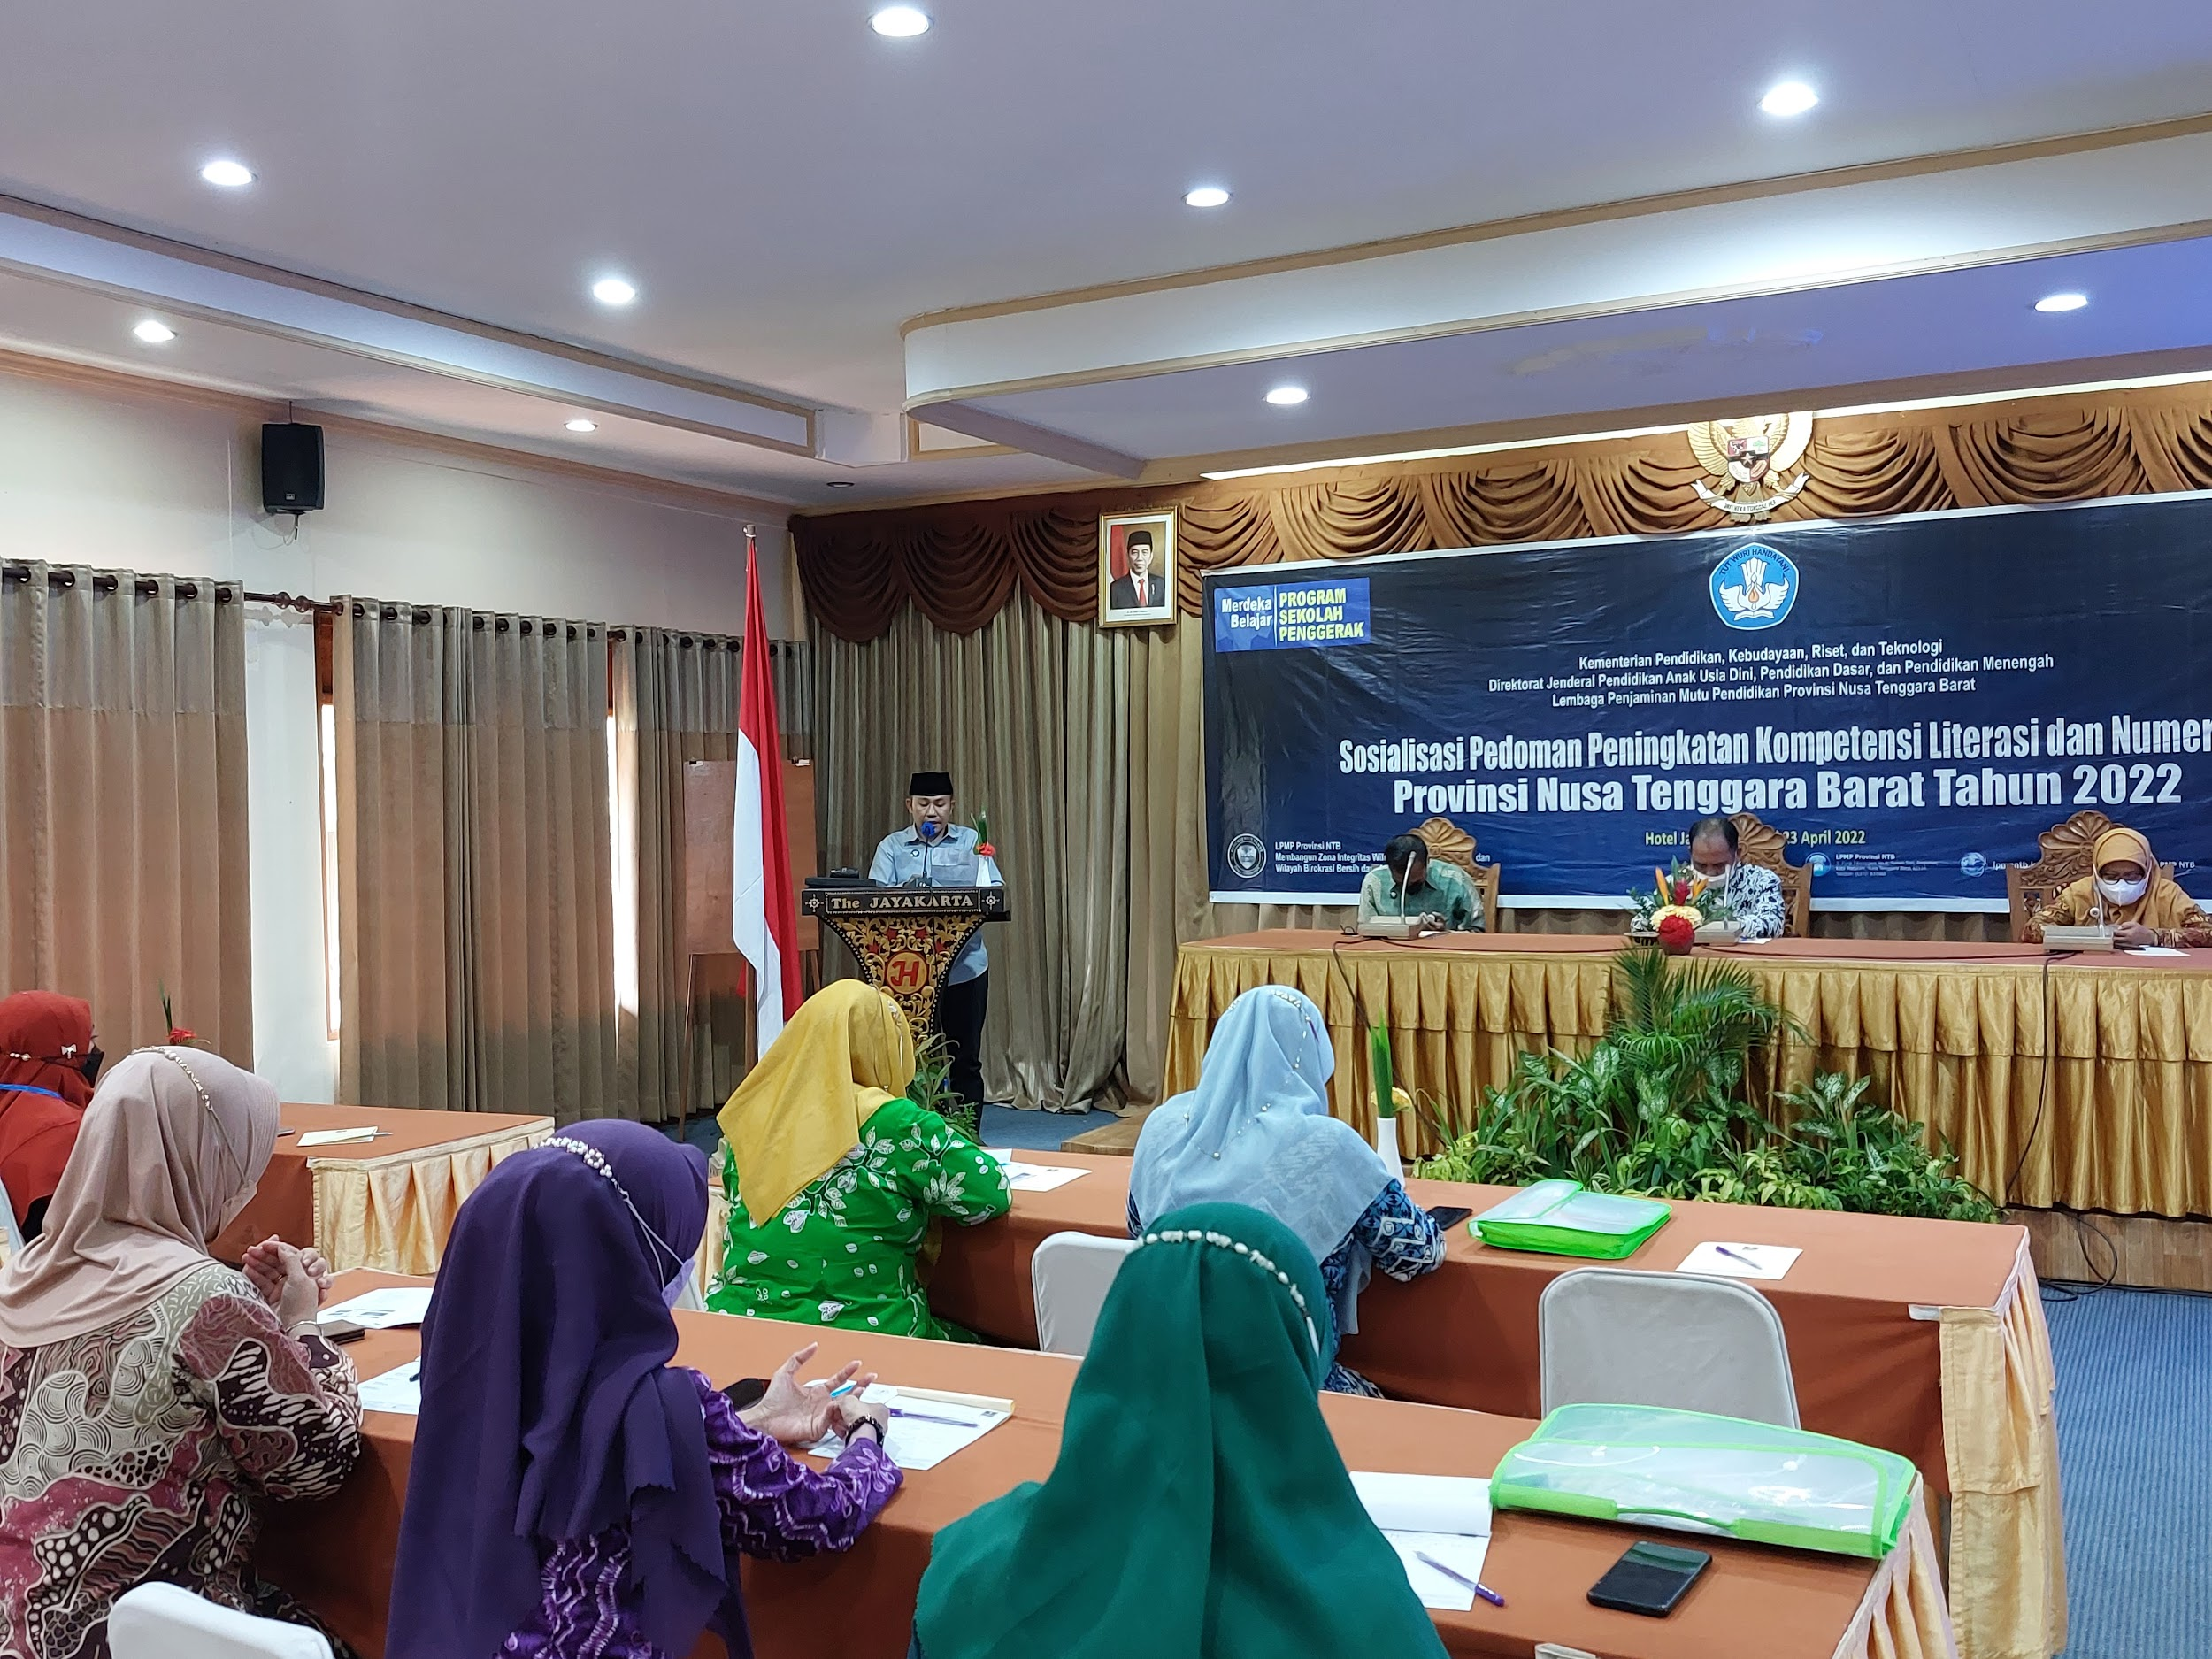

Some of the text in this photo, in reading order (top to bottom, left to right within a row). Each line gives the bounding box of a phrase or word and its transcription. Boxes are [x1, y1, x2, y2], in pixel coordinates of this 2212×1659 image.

[1719, 549, 1790, 575] TUT WURI HANDAYANI
[1222, 596, 1272, 612] Merdeka
[1279, 588, 1347, 608] PROGRAM
[1231, 613, 1272, 630] Belajar
[1279, 606, 1343, 625] SEKOLAH
[1279, 622, 1365, 641] PENGGERAK
[1579, 639, 1943, 670] Kementerian Pendidikan, Kebudayaan, Riset, dan Teknologi
[1488, 654, 2054, 692] Direktorat Jenderal Pendidikan Anak Usia Dini, Pendidikan Dasar, dan Pendidikan Menengah
[1552, 676, 1976, 709] Lembaga Penjaminan Mutu Pendidikan Provinsi Nusa Tenggara Barat
[1339, 736, 1464, 773] Sosialisasi
[1470, 734, 1582, 770] Pedoman
[1587, 729, 1749, 771] Peningkatan
[1755, 721, 1922, 766] Kompetensi
[1929, 718, 2039, 759] Literasi
[2047, 717, 2104, 757] dan
[1394, 762, 2183, 814] Provinsi Nusa Tenggara Barat Tahun 2022
[1275, 841, 1341, 850] LPMP Provinsi NTB
[1646, 831, 1678, 846] Hotel
[1801, 829, 1831, 848] April
[1834, 830, 1866, 845] 2022
[1275, 852, 1317, 863] Membangun
[1318, 853, 1336, 862] Zona
[1337, 853, 1371, 863] Integritas
[1475, 853, 1491, 863] dan
[1275, 864, 1302, 874] Wilayah
[1303, 864, 1335, 872] Birokrasi
[1336, 864, 1360, 872] Bersih
[831, 895, 974, 910] The JAYAKARTA
